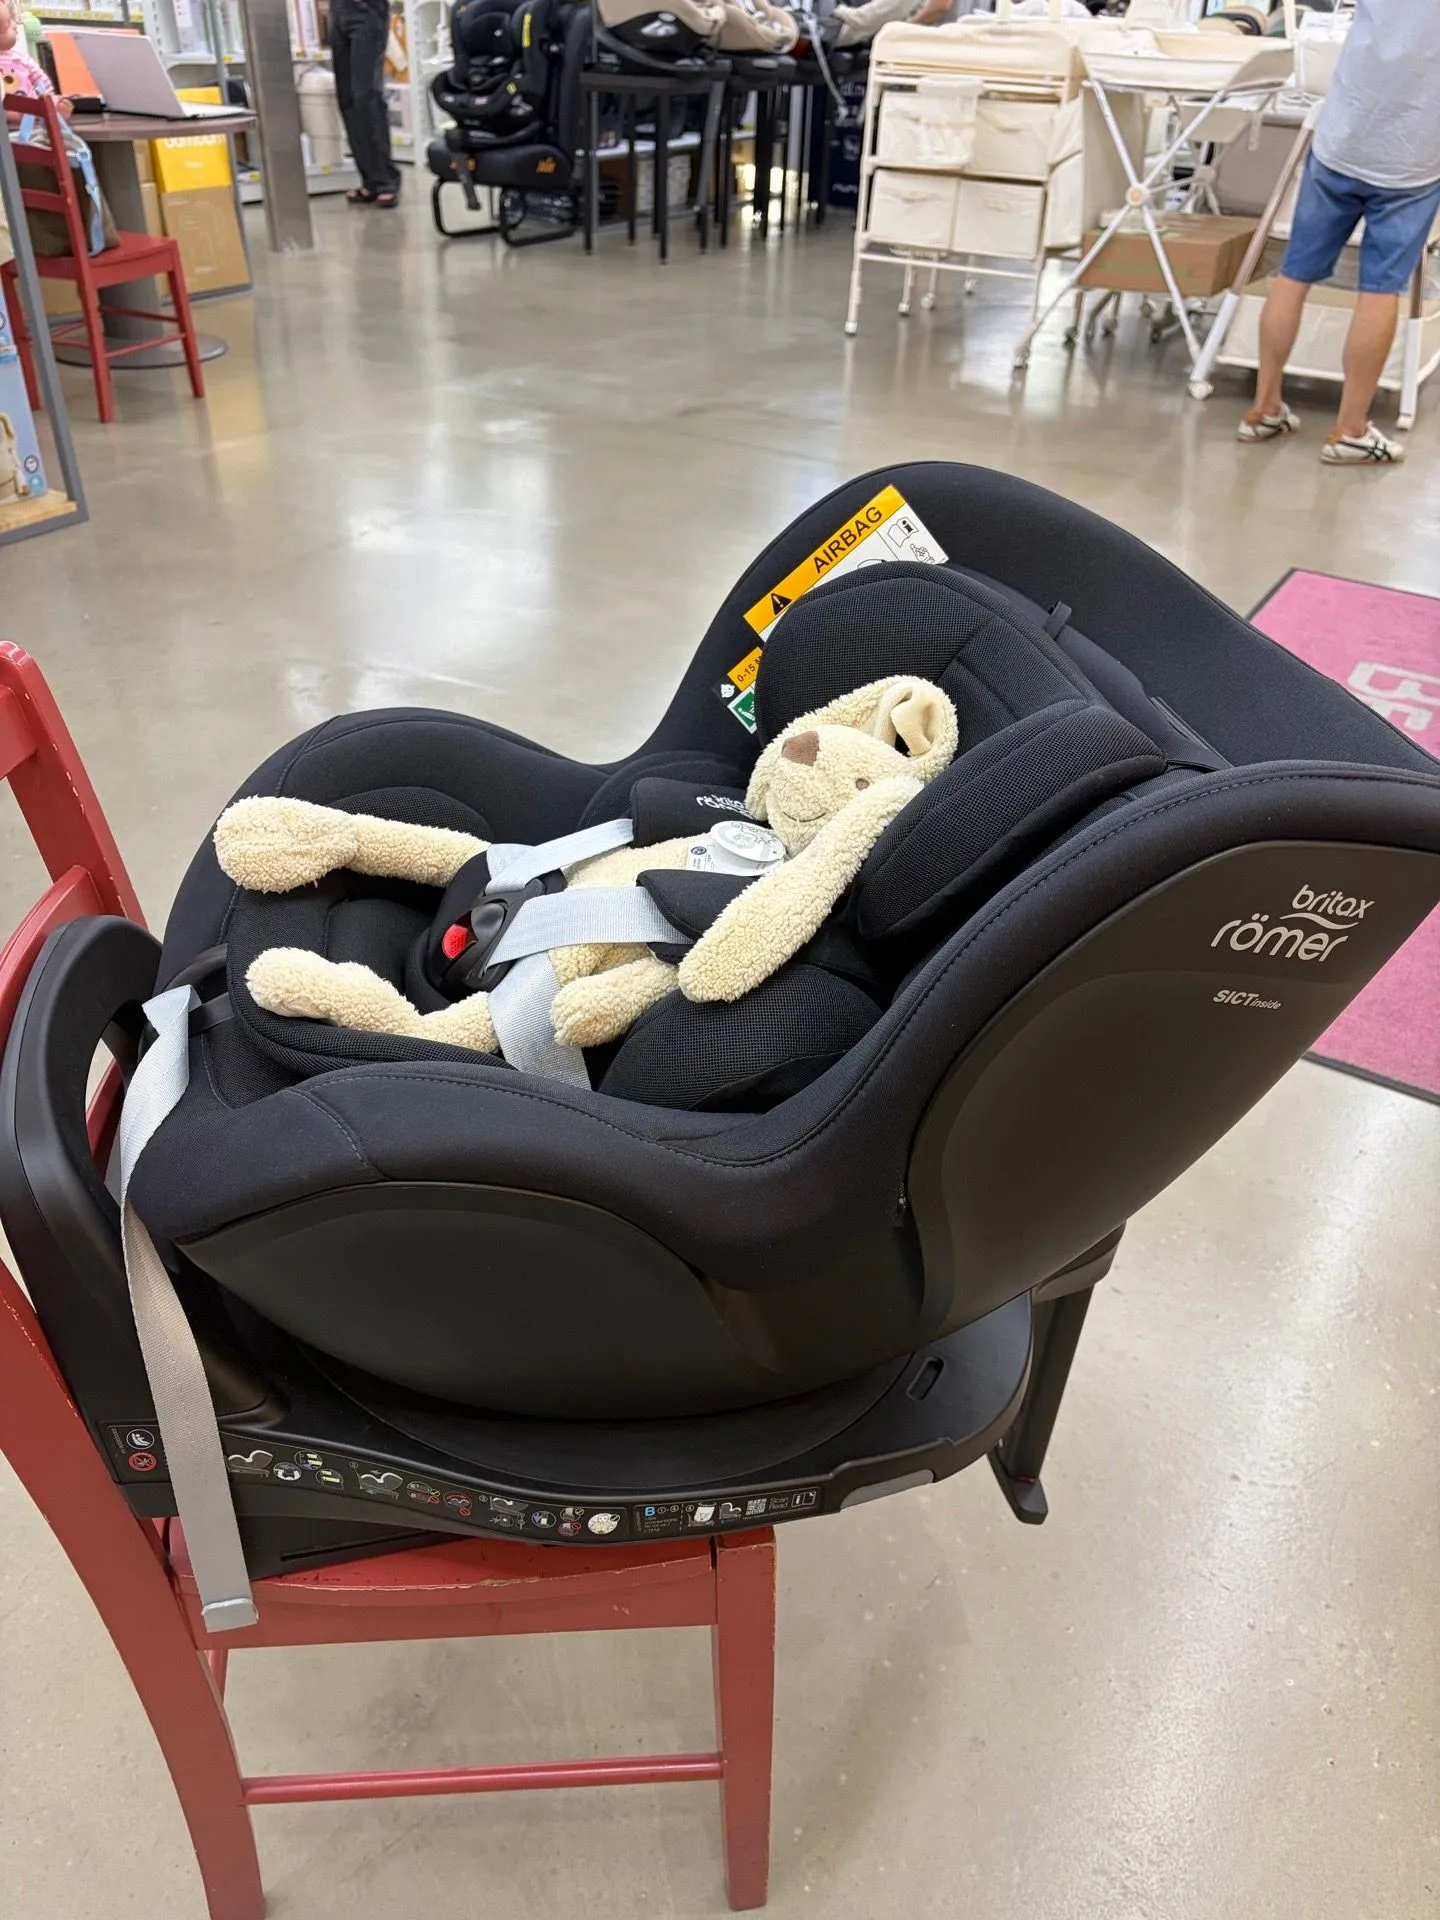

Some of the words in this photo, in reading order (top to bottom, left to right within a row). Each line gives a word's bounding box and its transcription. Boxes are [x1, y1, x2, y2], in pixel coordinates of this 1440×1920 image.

[812, 506, 882, 574] AIRBAG
[737, 664, 756, 682] 0-15
[1291, 884, 1375, 919] britax
[1210, 913, 1349, 962] römer
